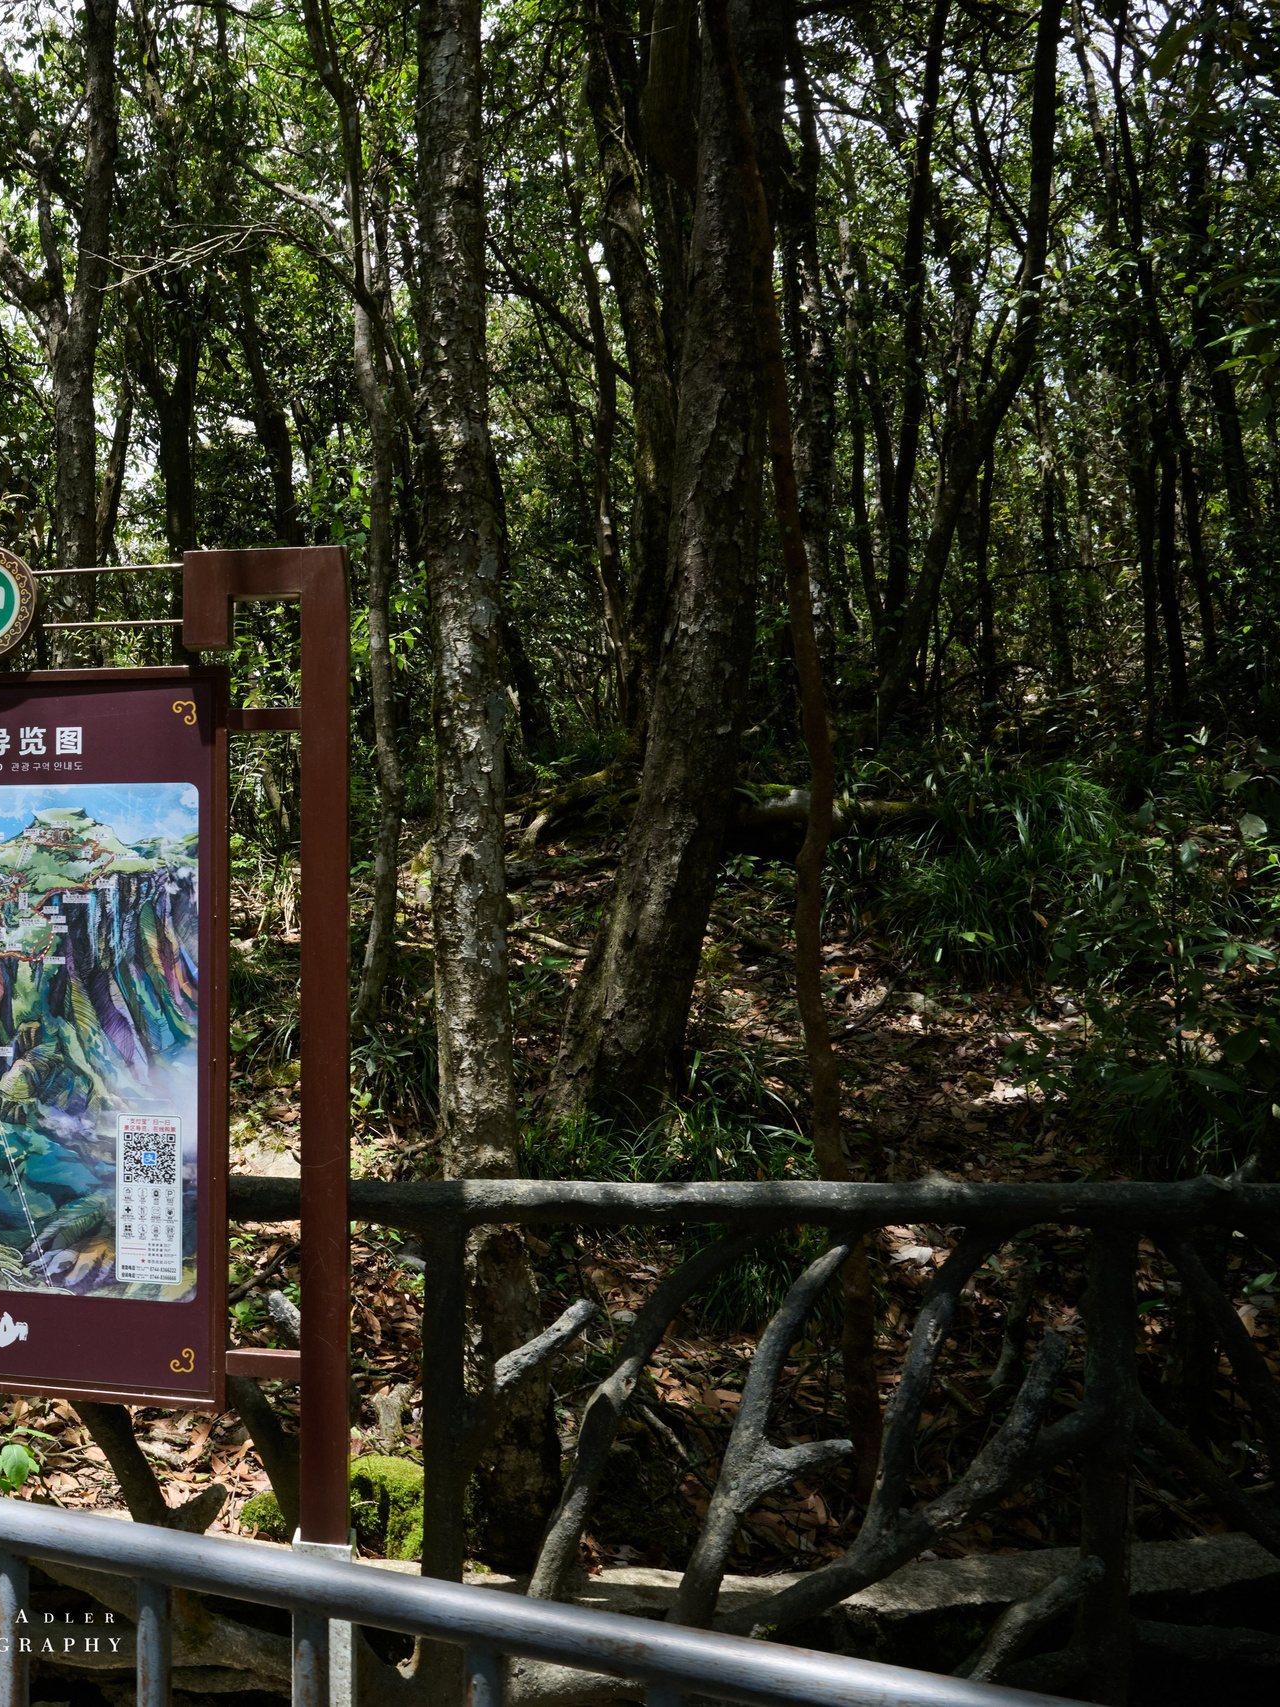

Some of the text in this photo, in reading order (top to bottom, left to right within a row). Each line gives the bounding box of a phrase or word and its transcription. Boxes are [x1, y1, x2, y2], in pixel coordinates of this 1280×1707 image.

[11, 761, 83, 772] 관광 구역 안내도
